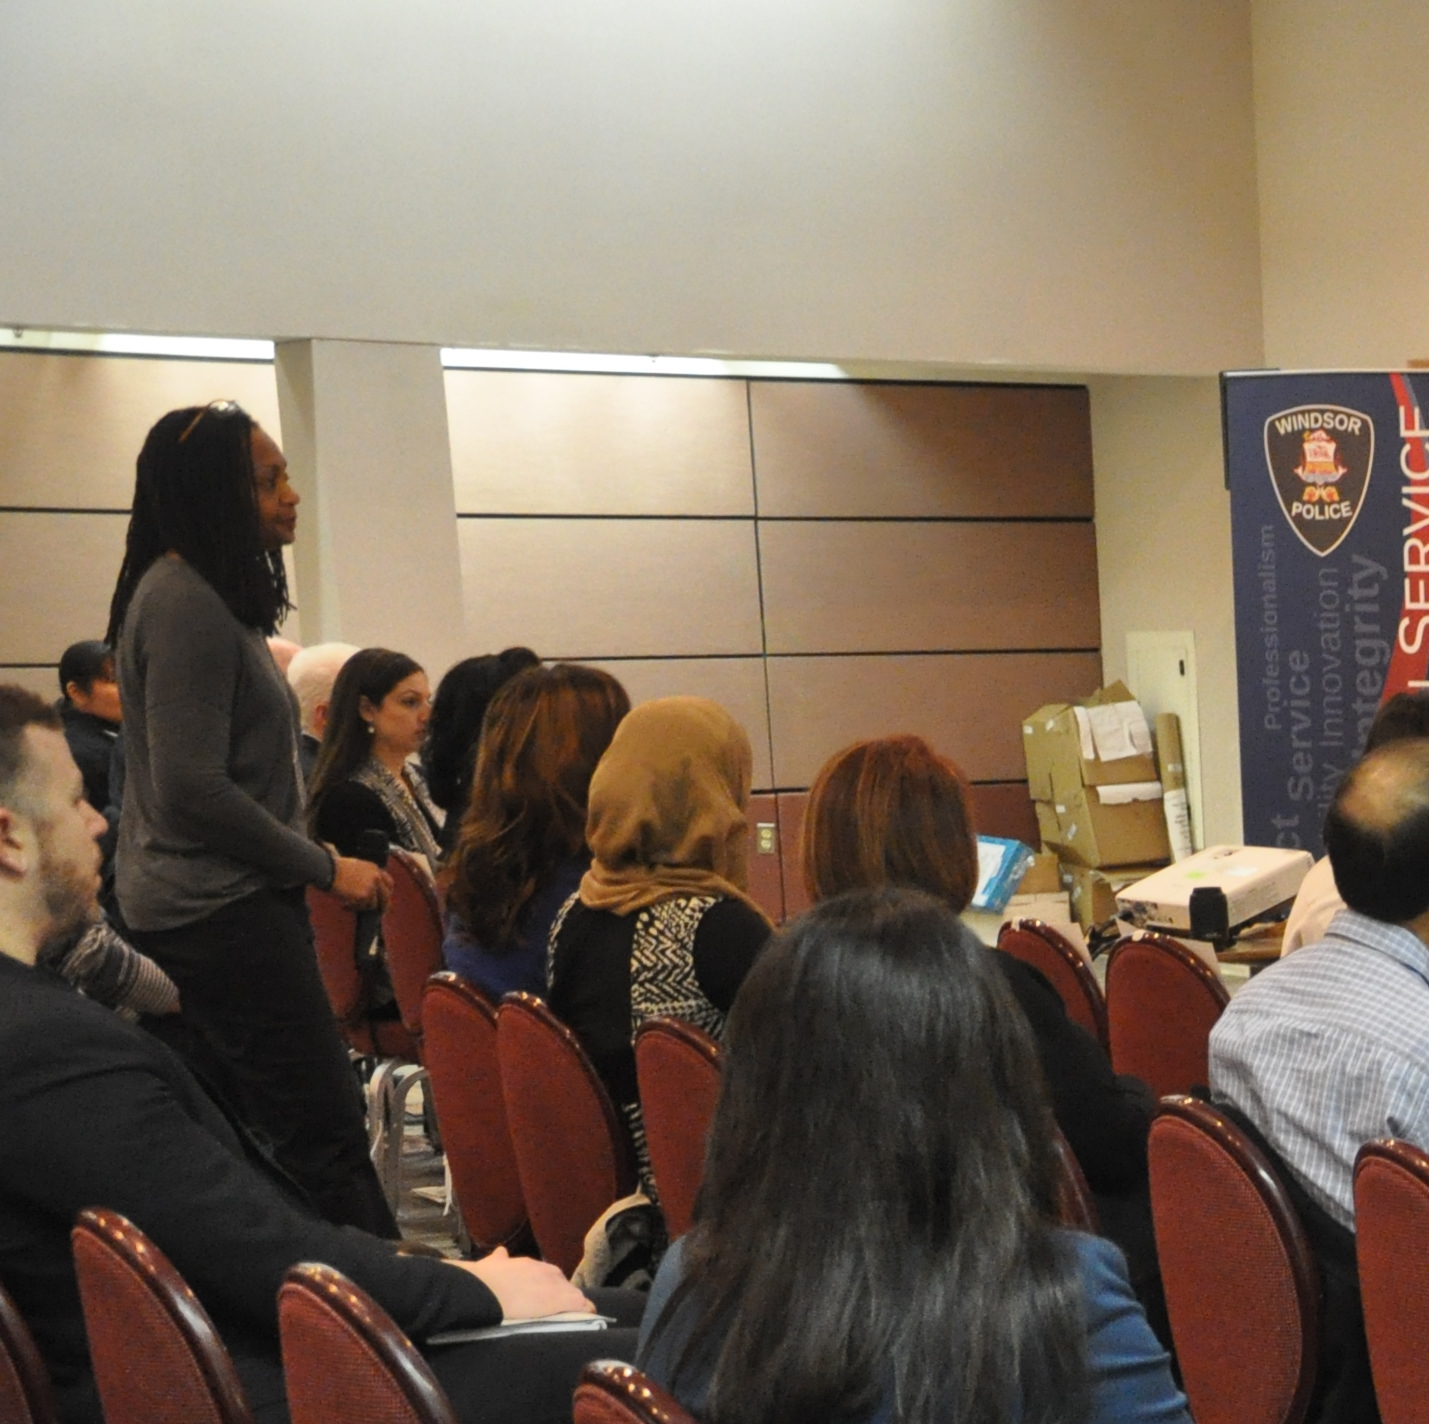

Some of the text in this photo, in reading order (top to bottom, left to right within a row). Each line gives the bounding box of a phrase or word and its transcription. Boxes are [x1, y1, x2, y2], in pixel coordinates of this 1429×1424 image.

[1275, 412, 1362, 435] WINDSOR
[1291, 501, 1352, 520] POLICE
[1256, 525, 1283, 731] Professionalism
[1317, 567, 1341, 747] Innovation
[1287, 650, 1314, 802] Service
